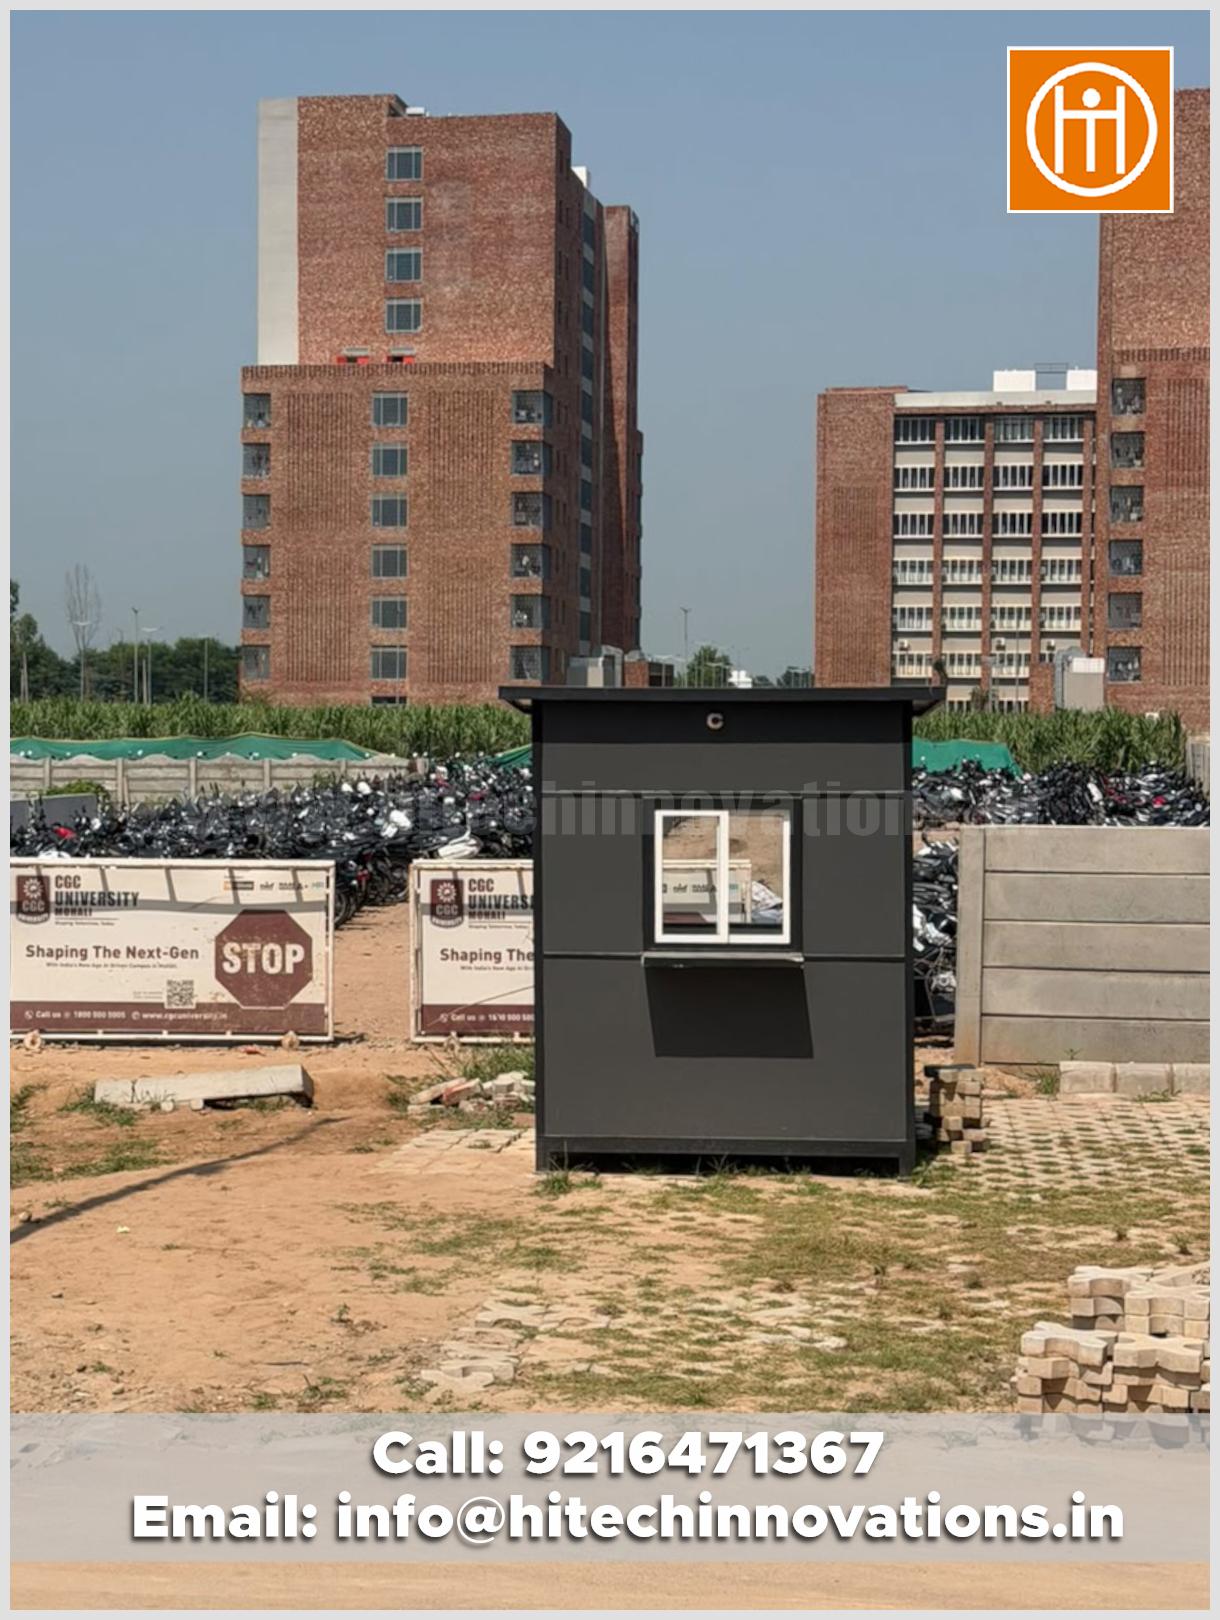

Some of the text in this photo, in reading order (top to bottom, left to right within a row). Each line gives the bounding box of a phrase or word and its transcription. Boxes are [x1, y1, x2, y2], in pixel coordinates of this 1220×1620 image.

[55, 875, 81, 889] CGC
[468, 878, 494, 892] CGC
[22, 900, 45, 912] CGC
[55, 891, 140, 907] UNIVERSITY
[435, 904, 459, 916] CGC
[25, 944, 200, 961] Shaping The Next-Gen
[222, 942, 305, 974] STOP
[440, 948, 534, 964] Shaping The
